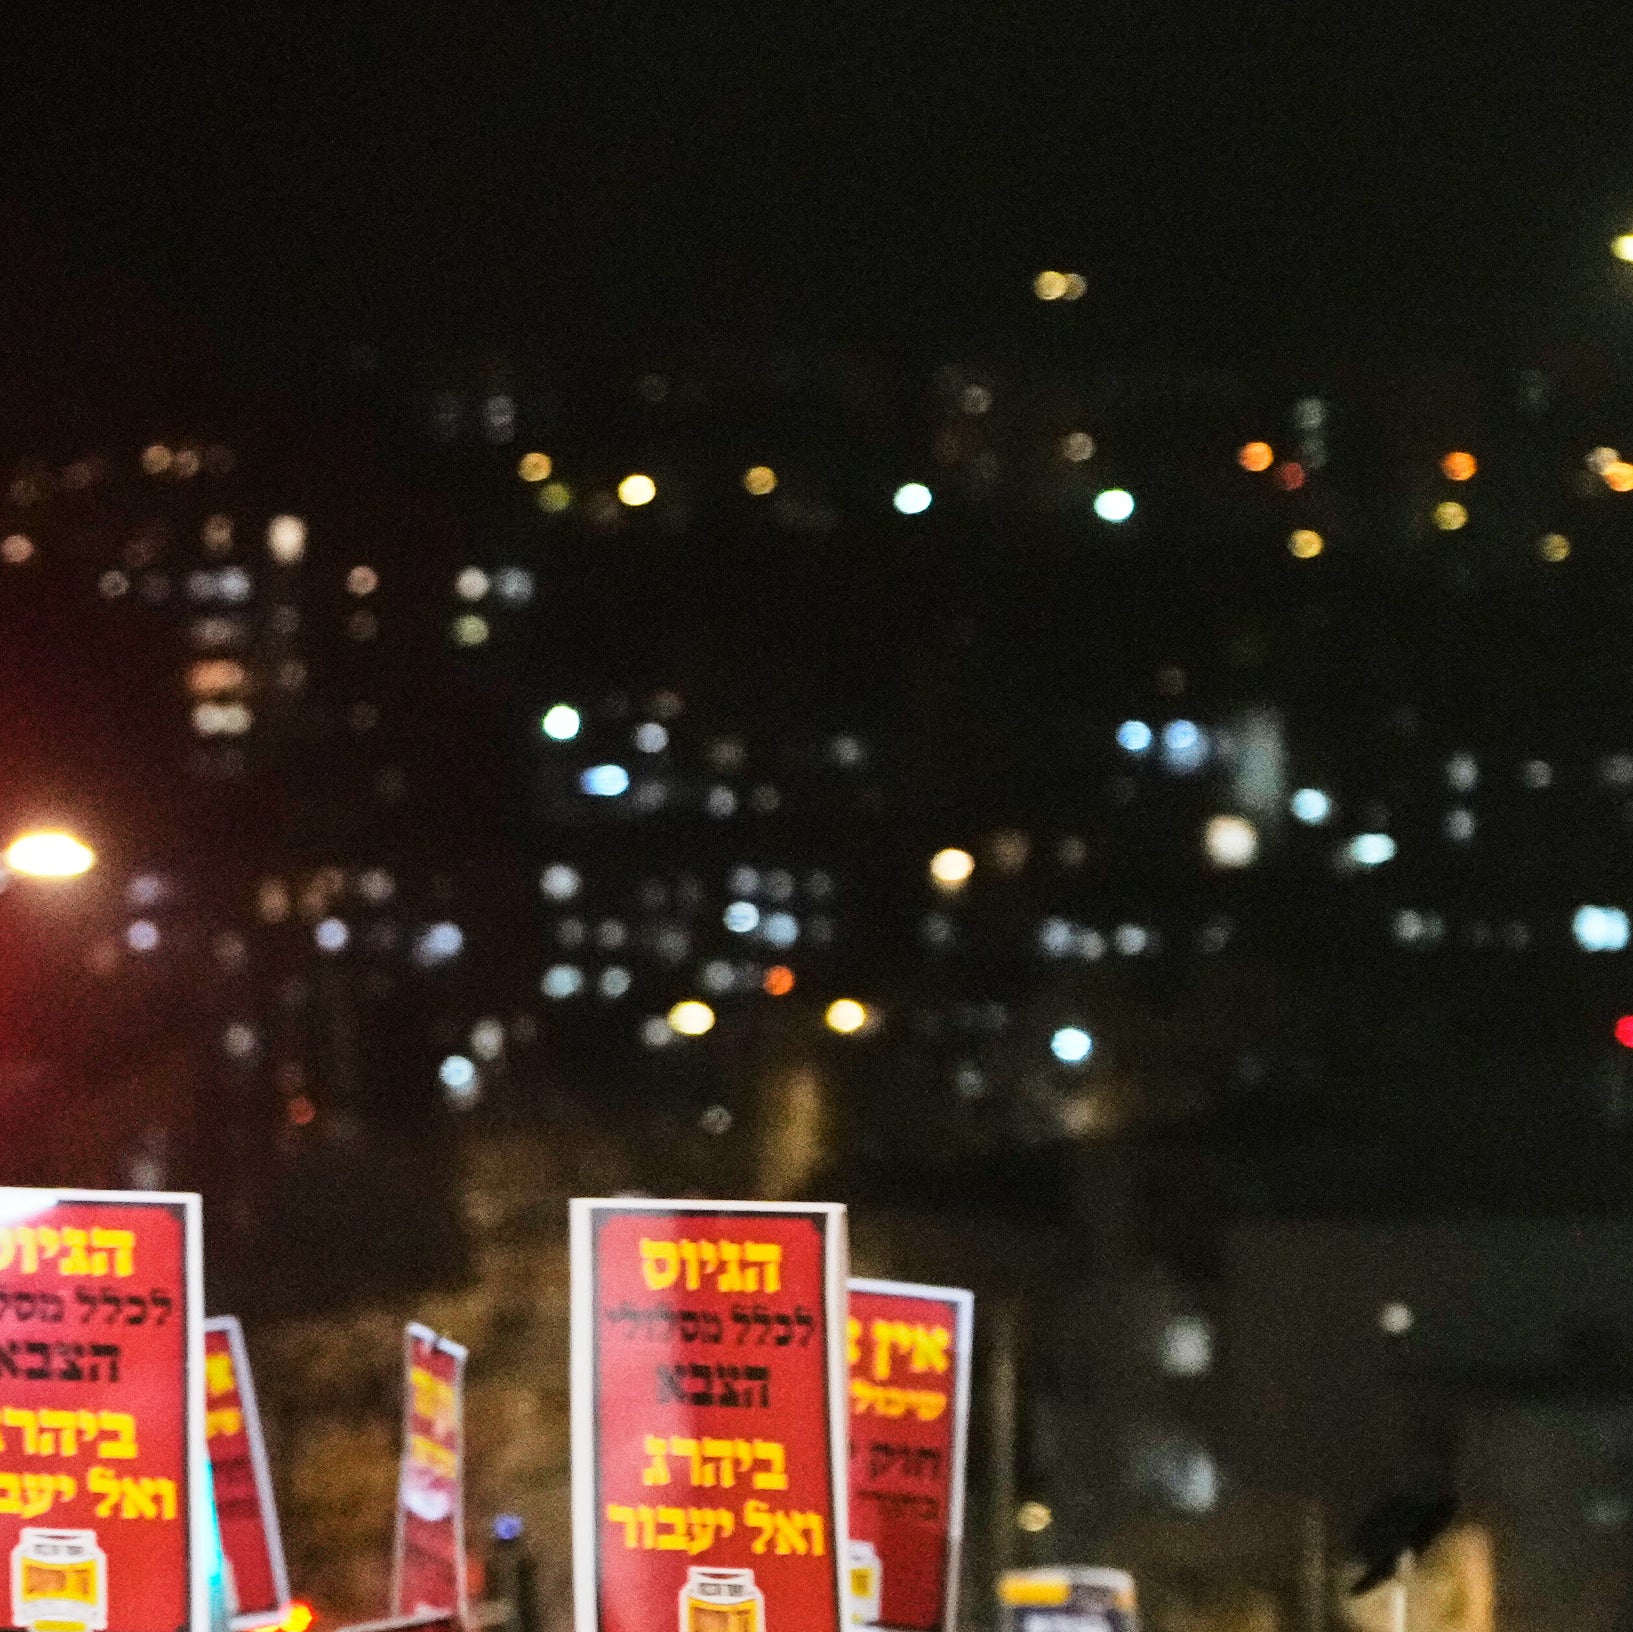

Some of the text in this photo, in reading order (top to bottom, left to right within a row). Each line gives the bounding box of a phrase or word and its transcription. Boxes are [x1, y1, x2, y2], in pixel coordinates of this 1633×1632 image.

[639, 1237, 782, 1294] הגיוס
[75, 1286, 171, 1325] לכלל
[731, 1303, 815, 1347] לכלל
[871, 1319, 951, 1380] אין
[657, 1364, 770, 1408] הצבא
[643, 1434, 788, 1491] ביהרג
[86, 1466, 176, 1520] ואל
[606, 1499, 826, 1556] ואל יעבור
